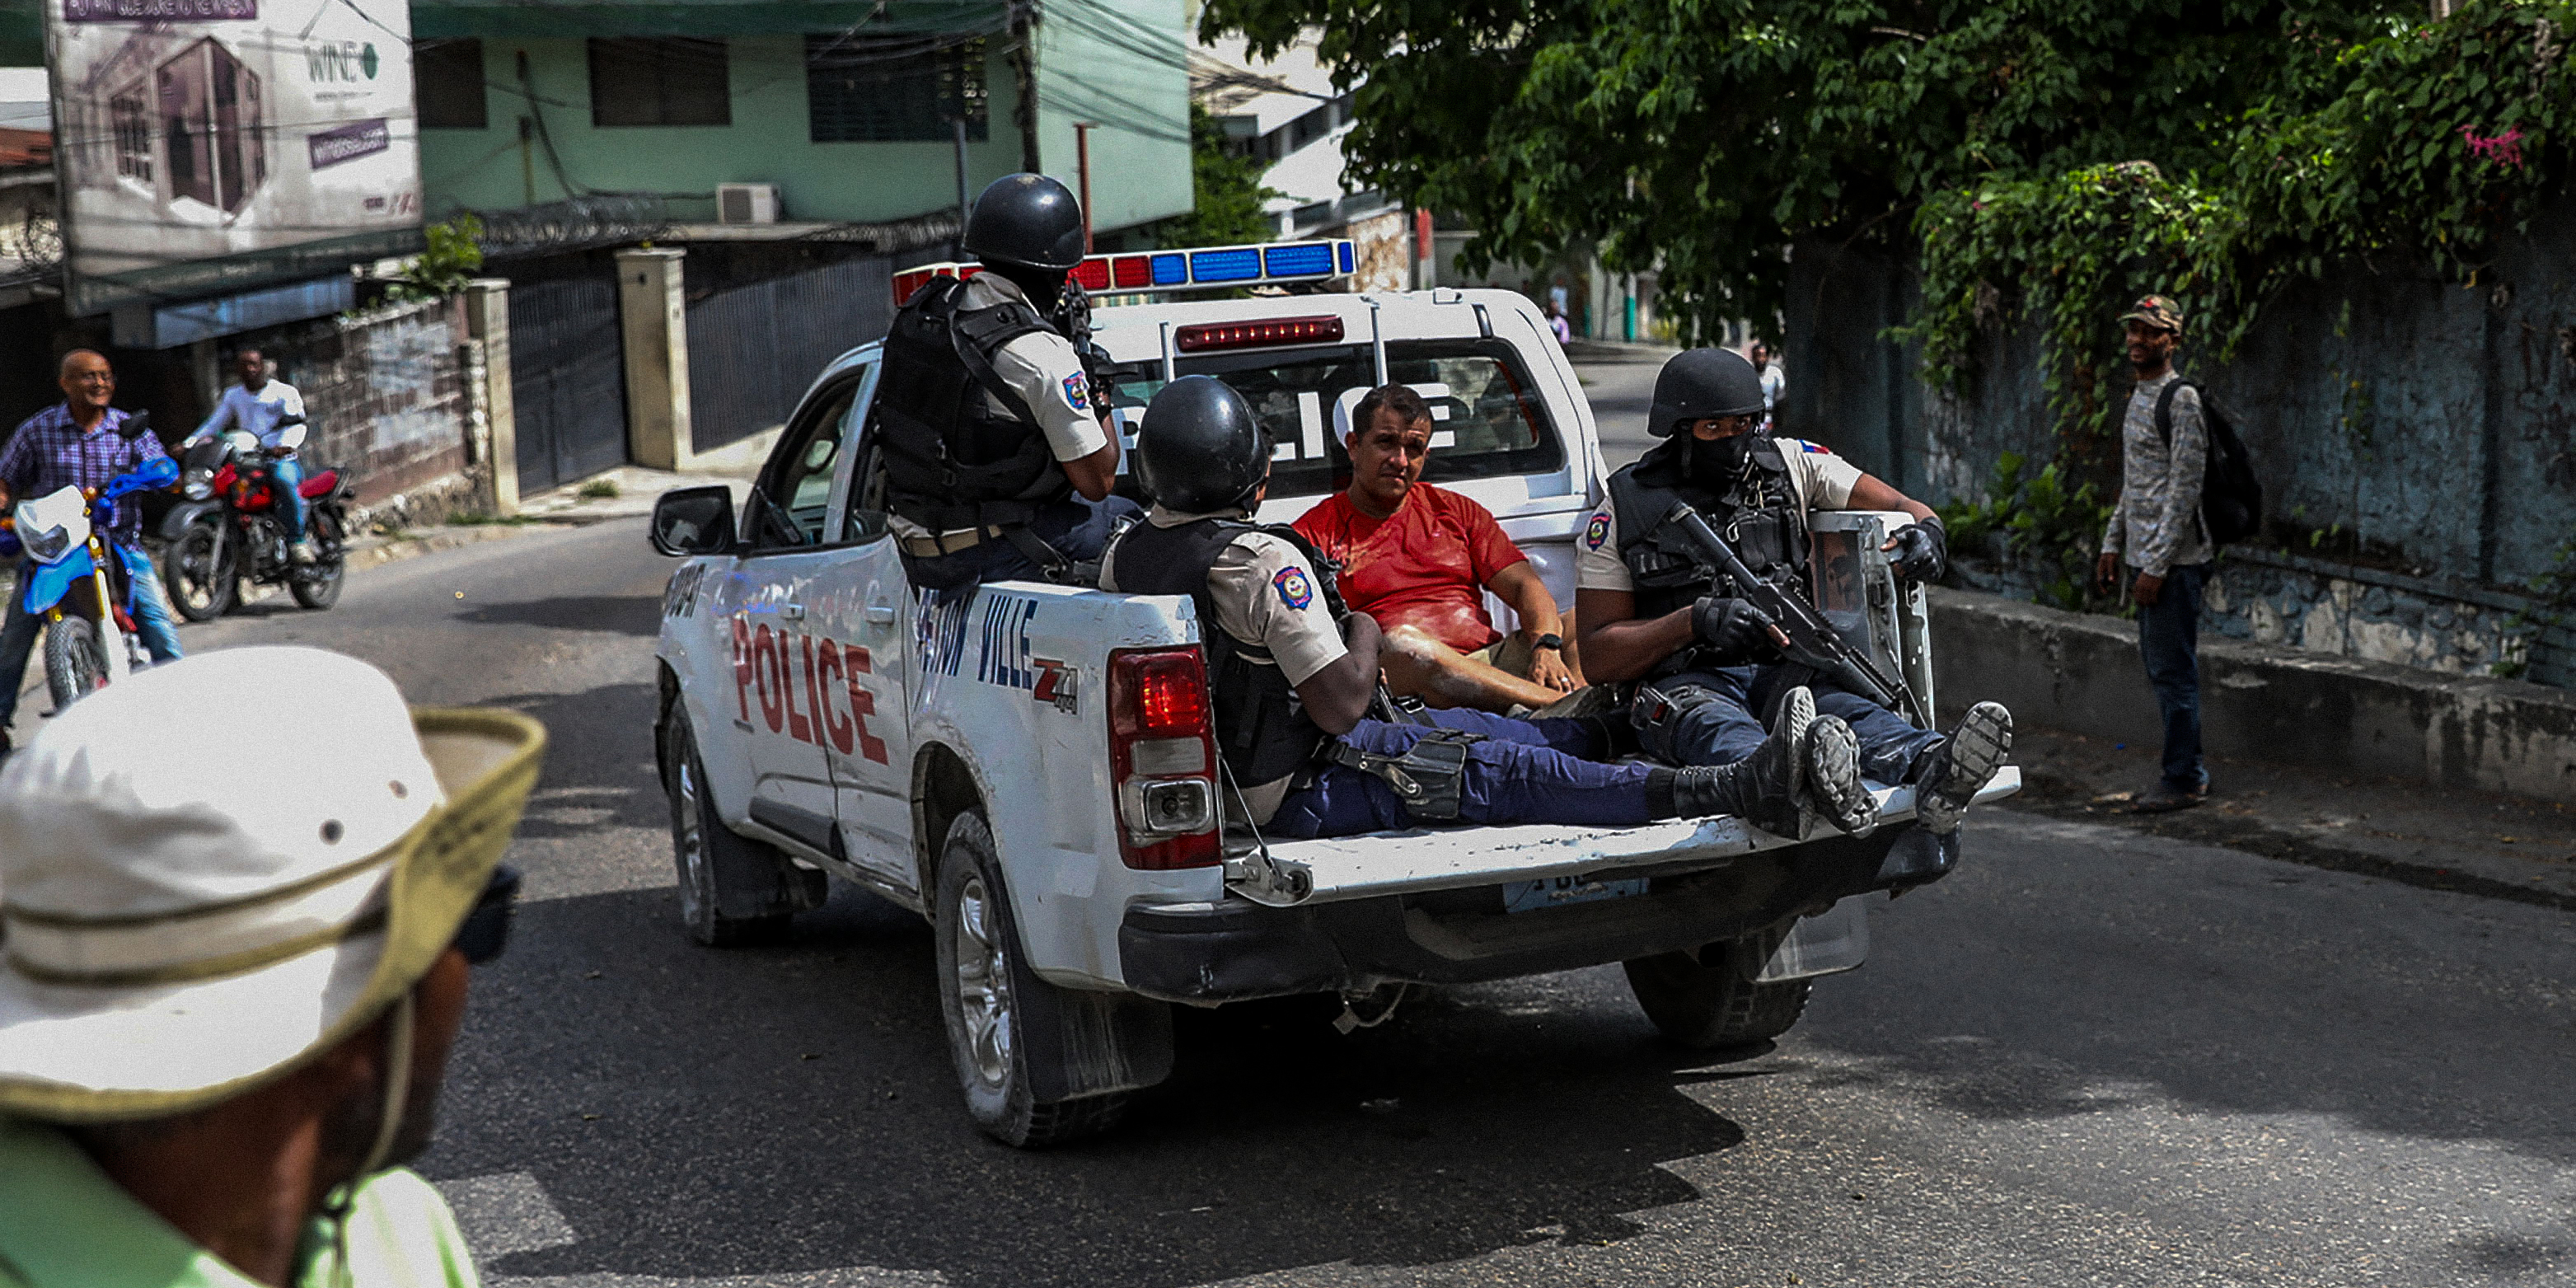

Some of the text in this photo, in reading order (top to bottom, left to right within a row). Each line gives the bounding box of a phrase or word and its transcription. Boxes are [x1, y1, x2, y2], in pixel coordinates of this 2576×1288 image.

[732, 616, 890, 766] POLICE
[977, 593, 1039, 691] VILLE
[1033, 657, 1079, 701] Z71
